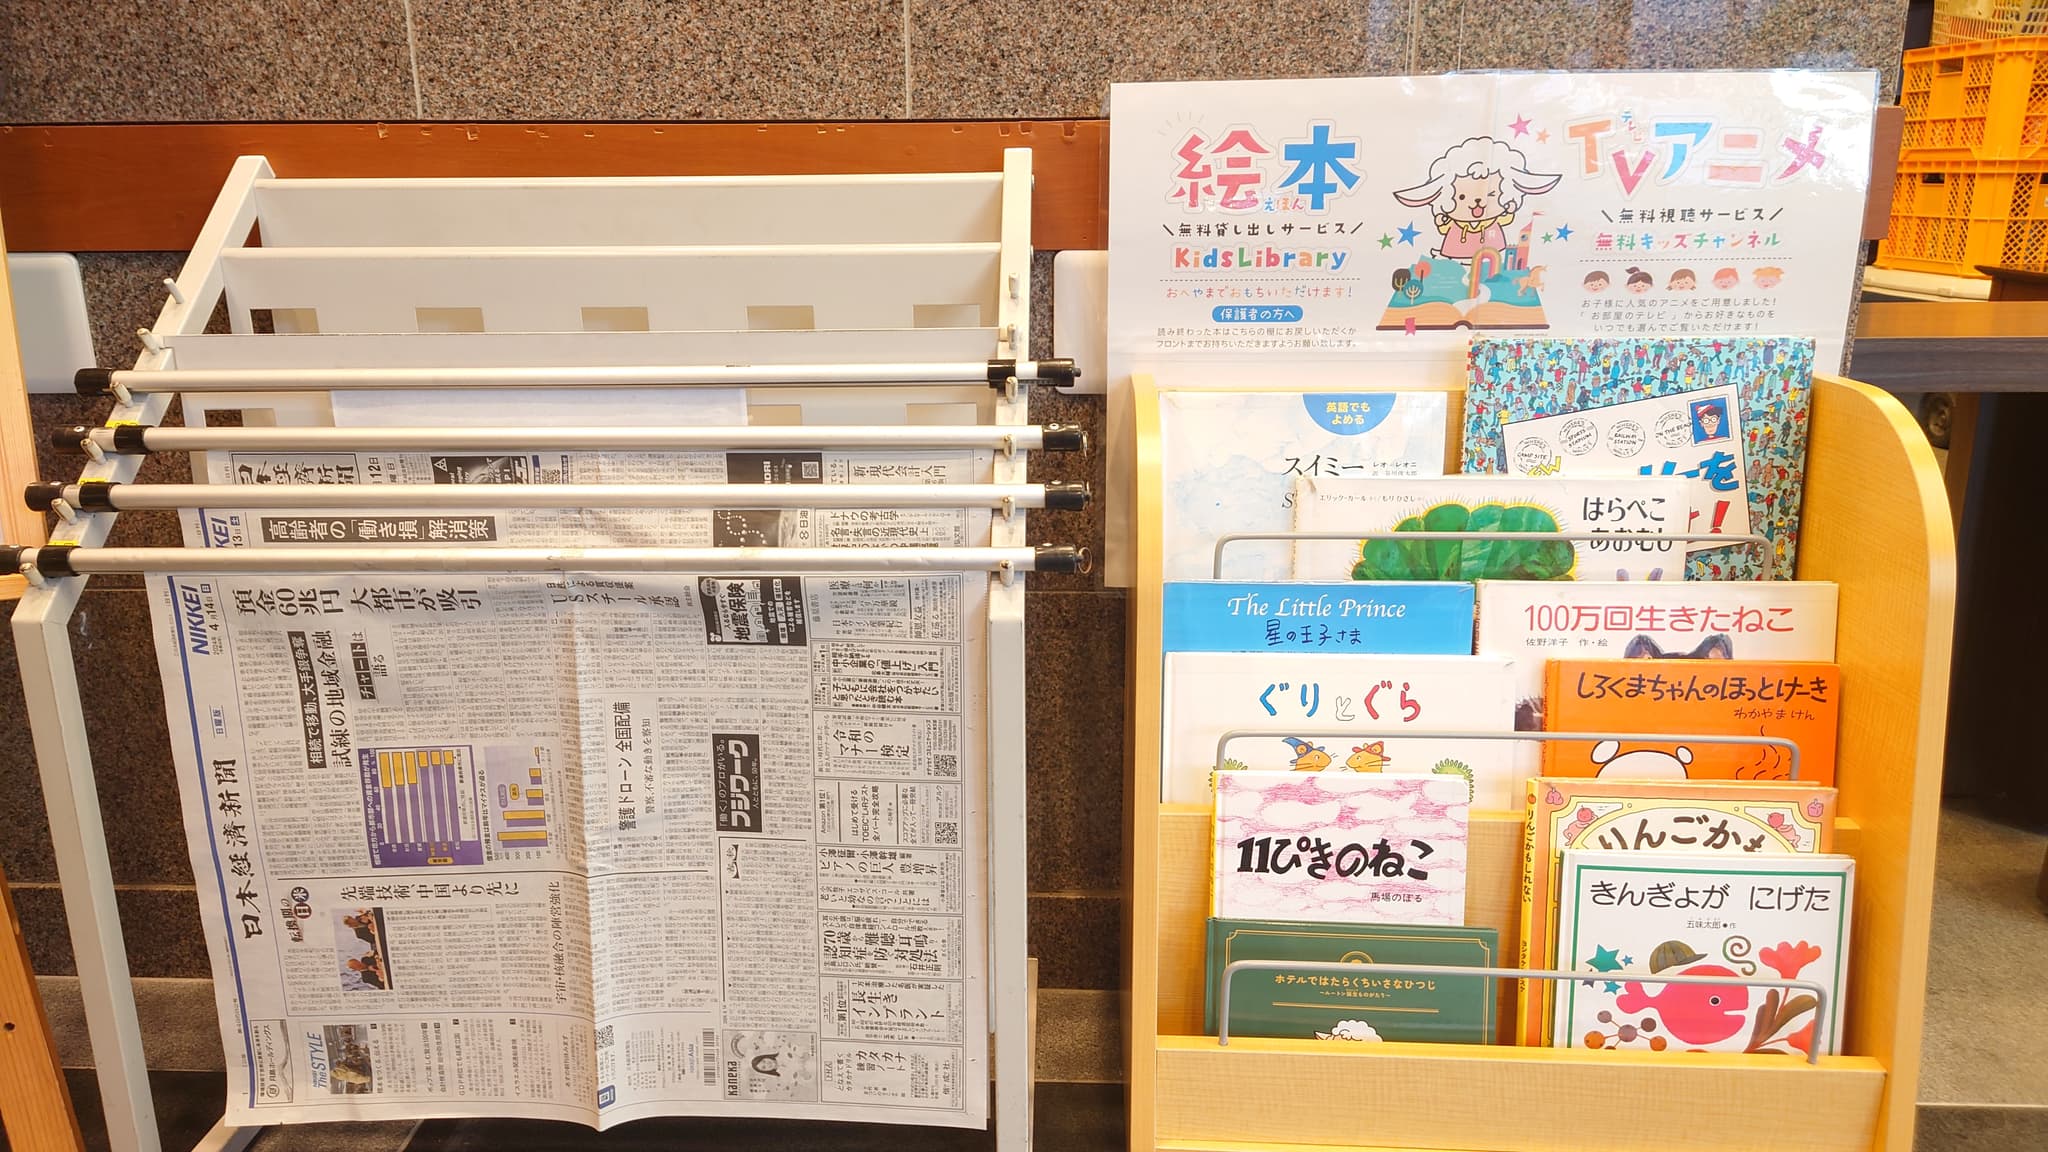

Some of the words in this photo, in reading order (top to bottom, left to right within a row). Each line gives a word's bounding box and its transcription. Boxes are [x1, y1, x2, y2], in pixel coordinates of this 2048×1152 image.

[1171, 125, 1361, 210] 絵本
[1264, 197, 1305, 212] えほん
[1619, 207, 1765, 224] 無料視聴サービス
[1178, 223, 1346, 237] 無料貸し出しサービス
[1595, 231, 1781, 251] 無料キッズチャンネル
[1220, 308, 1295, 321] 保護者の方へ
[1326, 402, 1370, 413] 英語でも
[1331, 414, 1365, 425] よめる
[1282, 454, 1364, 477] スイミー
[831, 510, 898, 520] ドナウの考古学
[1583, 496, 1665, 522] はらぺこ
[268, 518, 489, 541] 高齢者の「働き損」解消策
[232, 587, 343, 617] 預金60兆円
[350, 586, 482, 613] 大都市が吸引
[727, 582, 751, 641] 地震保険
[1227, 593, 1269, 616] The
[1274, 593, 1332, 617] Little
[1338, 599, 1406, 618] Prince
[181, 585, 210, 655] NIKKEI
[1524, 604, 1795, 632] 100万回生きたねこ
[1265, 619, 1363, 646] 星の王子さま
[1525, 638, 1569, 647] 佐野洋子
[352, 632, 376, 699] チャートは
[374, 655, 388, 676] 語る
[832, 659, 939, 672] 中小企業の「値上げ」入門
[292, 636, 323, 763] 相続で移動、大手銀争奪
[311, 631, 352, 767] 試練の地域金融
[832, 684, 939, 695] 子どもに会社をつがせたい
[832, 694, 903, 704] と思ったとき読む本
[1577, 672, 1829, 703] しろくまちゃんのほっとけーき
[1259, 681, 1421, 722] ぐりとぐら
[212, 708, 224, 734] 日曜版
[1734, 707, 1786, 720] わかやま
[1791, 709, 1816, 721] けん
[612, 702, 632, 752] 全国配備
[833, 729, 874, 743] 令和の
[839, 743, 910, 758] マナー検定
[641, 718, 655, 814] 警察、不審な動きを察知
[618, 758, 636, 831] 警護ドローン
[728, 739, 751, 827] フジワーク
[851, 789, 859, 836] はじめて受ける
[872, 785, 880, 842] 全パート完全攻略
[212, 758, 264, 939] 日本経済新聞
[1237, 836, 1435, 881] 11ぴきのねこ
[1522, 808, 1536, 904] りんごかもしれない
[820, 860, 895, 873] ピアノの巨人
[899, 863, 937, 875] 豊増昇
[340, 881, 519, 901] 先端技術、中国より先に
[1370, 892, 1423, 903] 馬場のぼる
[1590, 880, 1730, 910] きんぎょが
[1750, 885, 1831, 912] にげた
[548, 881, 567, 1004] 宇宙・核融合の陣営強化
[910, 963, 942, 971] 石井正則
[1275, 974, 1437, 991] ホテルではたらくちいさなひつじ
[852, 990, 898, 1004] 長生き
[852, 1007, 945, 1020] インプラント
[264, 1025, 276, 1081] 月島ホールディングス
[306, 1032, 326, 1071] STYLE
[856, 1050, 907, 1063] カタカナ
[857, 1062, 906, 1071] 練習ノート
